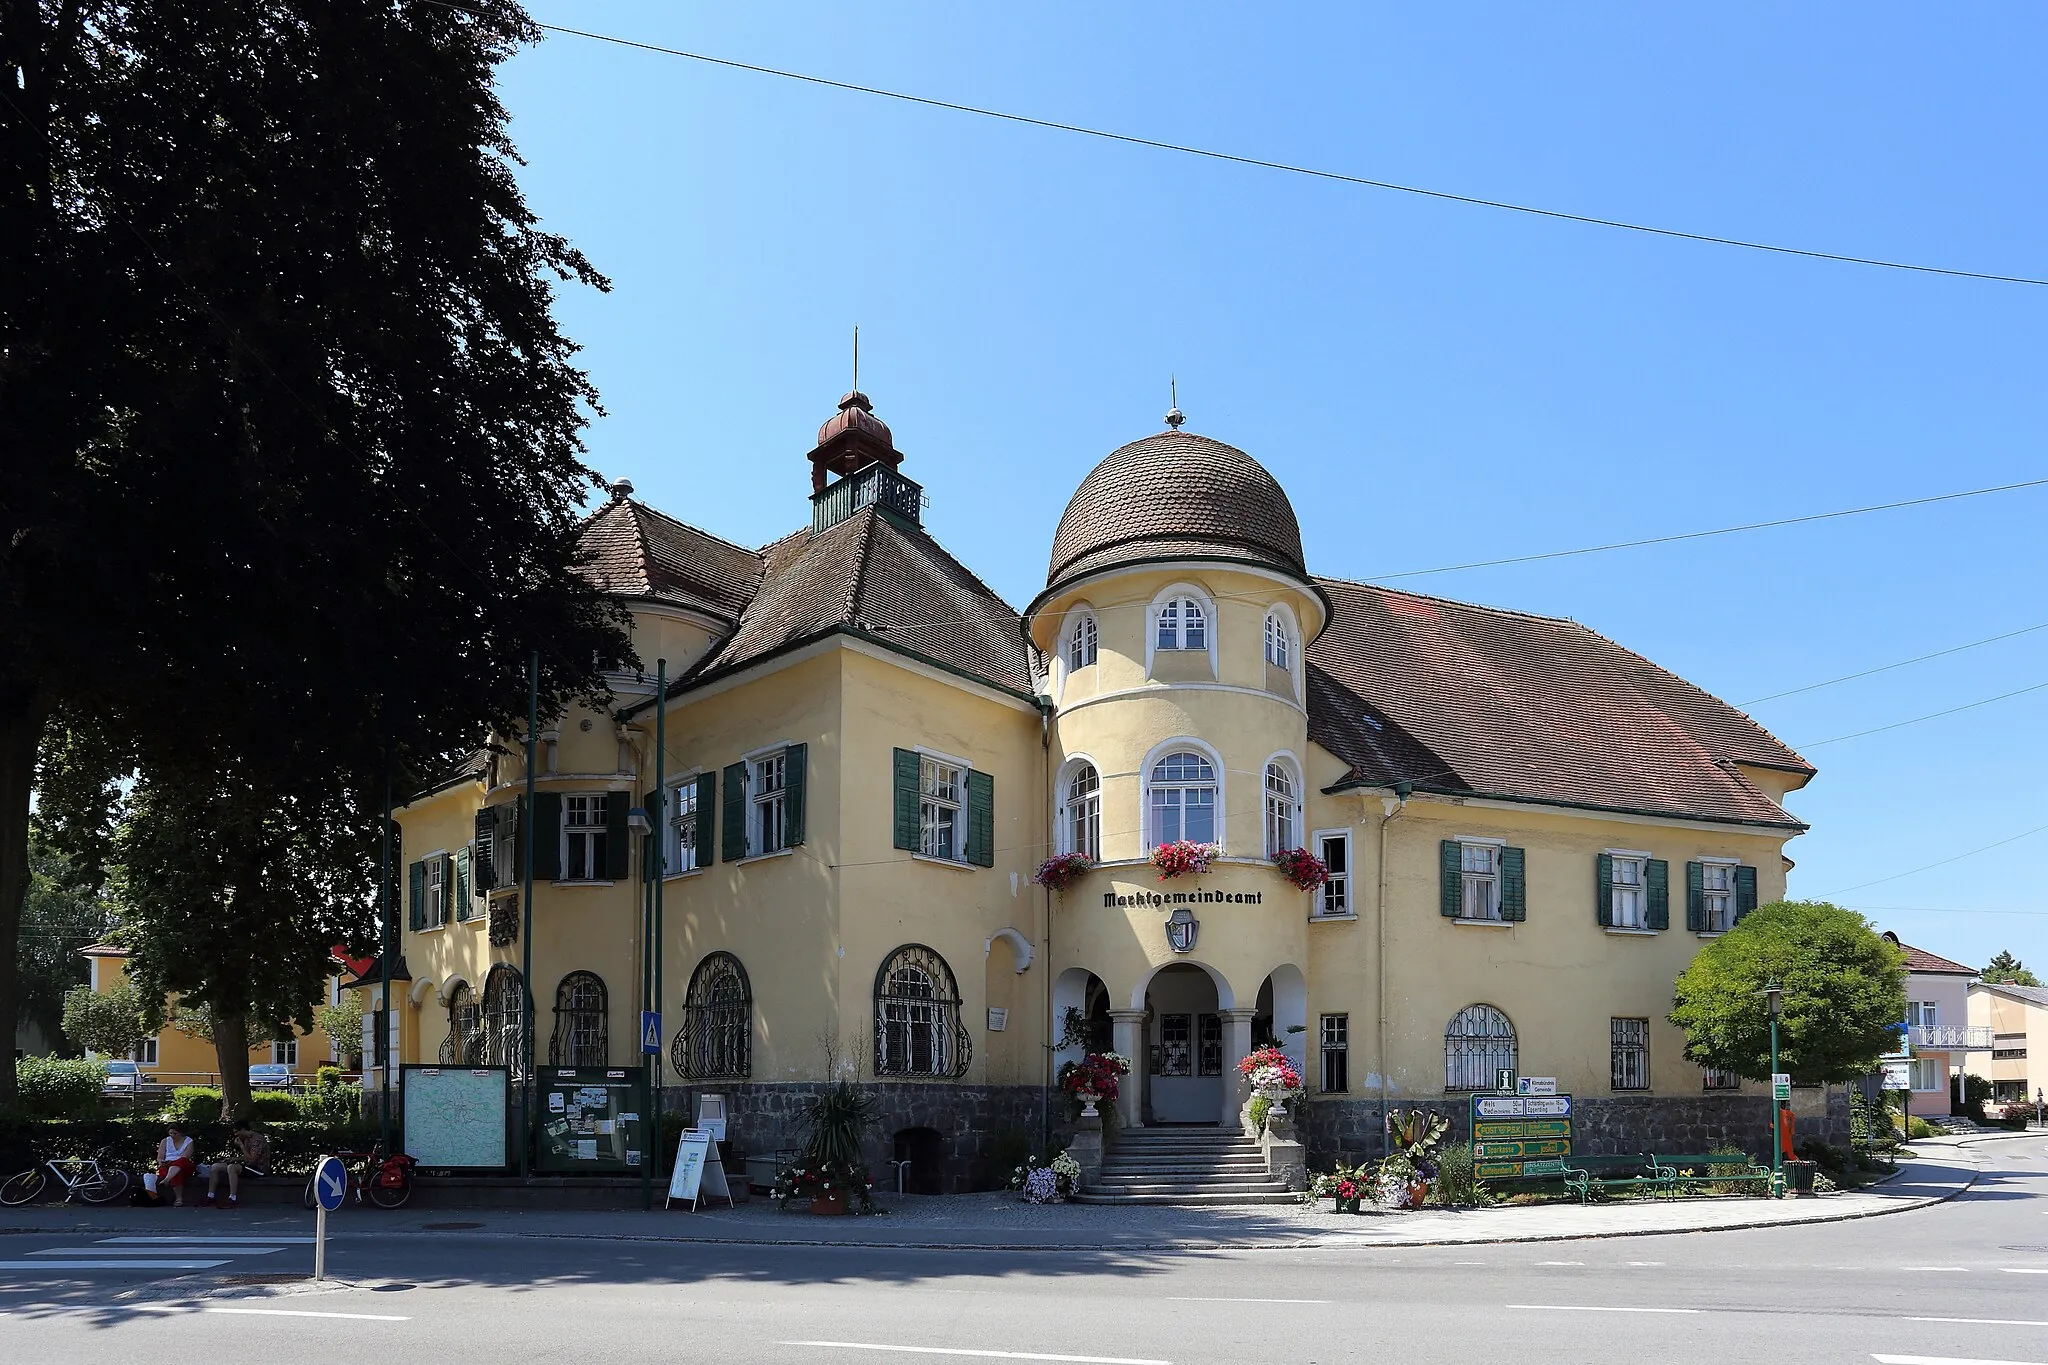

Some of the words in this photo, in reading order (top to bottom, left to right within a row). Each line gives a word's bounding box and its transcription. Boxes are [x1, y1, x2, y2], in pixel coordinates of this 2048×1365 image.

[1103, 888, 1262, 908] Marktgemeindeamt
[1481, 1126, 1497, 1134] POST
[1487, 1146, 1514, 1155] Sparkasse
